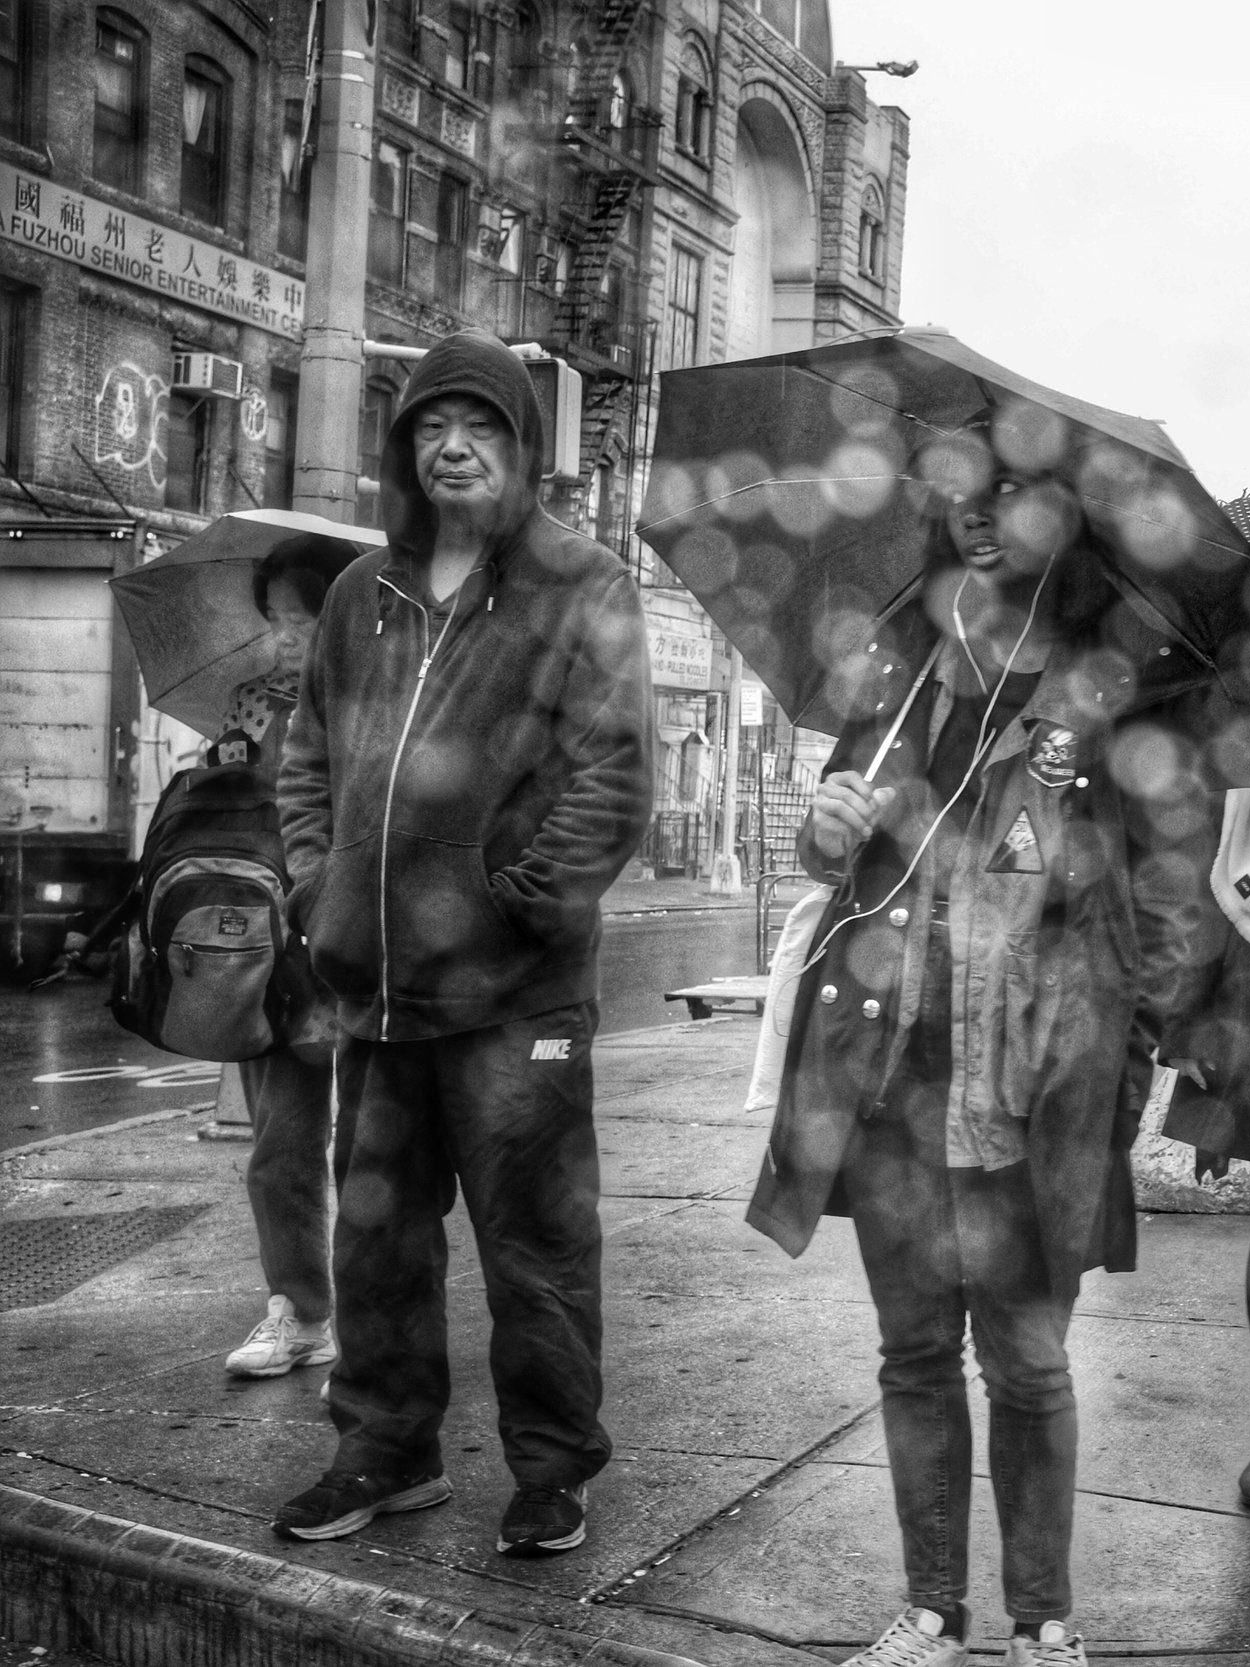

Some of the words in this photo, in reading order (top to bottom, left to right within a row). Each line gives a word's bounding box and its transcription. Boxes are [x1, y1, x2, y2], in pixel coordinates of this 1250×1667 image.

[11, 214, 86, 261] FUZHOU
[91, 245, 153, 281] SENIOR
[158, 270, 279, 328] ENTERTAINMENT
[281, 314, 303, 334] CE
[530, 1039, 572, 1060] NIKE
